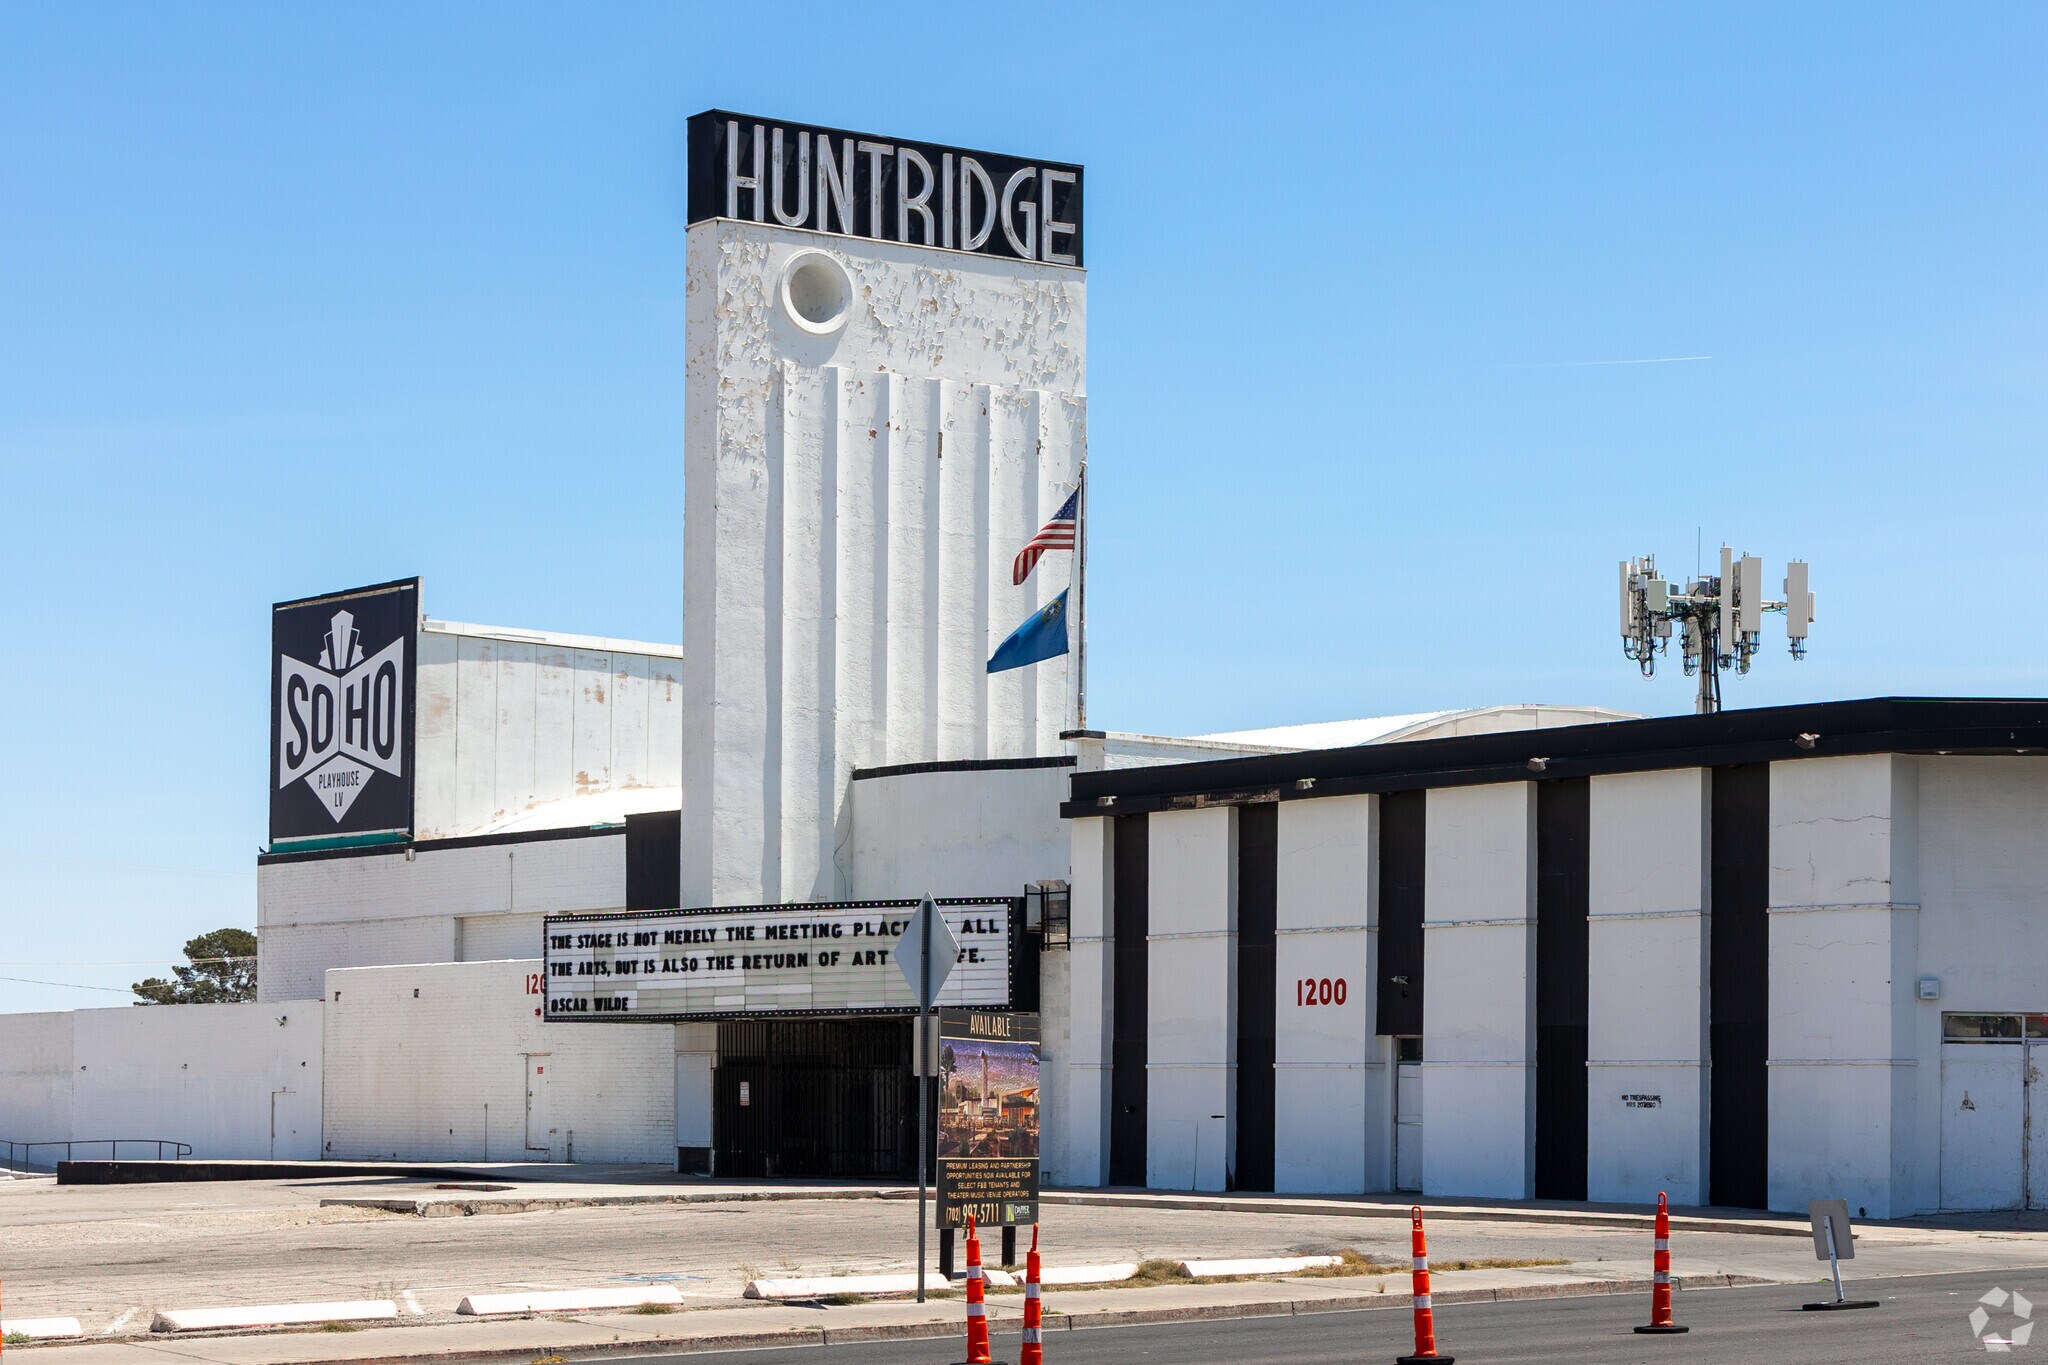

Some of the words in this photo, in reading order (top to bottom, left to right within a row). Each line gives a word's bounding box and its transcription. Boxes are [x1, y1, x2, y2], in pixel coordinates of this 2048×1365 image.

[726, 120, 1076, 266] HUNTRIDGE
[286, 660, 396, 770] SOHO
[318, 770, 360, 790] PLAYHOUSE
[334, 792, 344, 808] LV
[550, 935, 572, 949] THE
[577, 933, 612, 949] STAGE
[617, 932, 628, 947] IS
[634, 931, 658, 946] NOT
[664, 928, 717, 945] MERELY
[725, 926, 755, 941] THE
[765, 923, 842, 940] MEETING
[961, 919, 999, 934] ALL
[550, 962, 572, 977] THE
[577, 960, 611, 977] ARTS,
[615, 959, 638, 975] BUT
[644, 959, 655, 974] IS
[662, 957, 698, 973] ALSO
[706, 955, 735, 970] THE
[742, 952, 808, 970] RETURN
[818, 951, 840, 967] OF
[851, 949, 889, 966] ART
[526, 973, 544, 995] 120
[1297, 977, 1347, 1007] 1200
[550, 997, 588, 1012] OSCAR
[593, 997, 629, 1012] WILDE
[970, 1014, 1011, 1037] AVAILABLE
[946, 1162, 968, 1170] PREMIUM
[946, 1171, 982, 1180] OPPORTUNITIES
[983, 1171, 995, 1179] NOW
[995, 1171, 1020, 1179] AVAILABLE
[957, 1181, 976, 1189] SELECT
[988, 1181, 1009, 1189] TENANTS
[1002, 1190, 1030, 1198] OPERATORS
[946, 1206, 960, 1224] (702)
